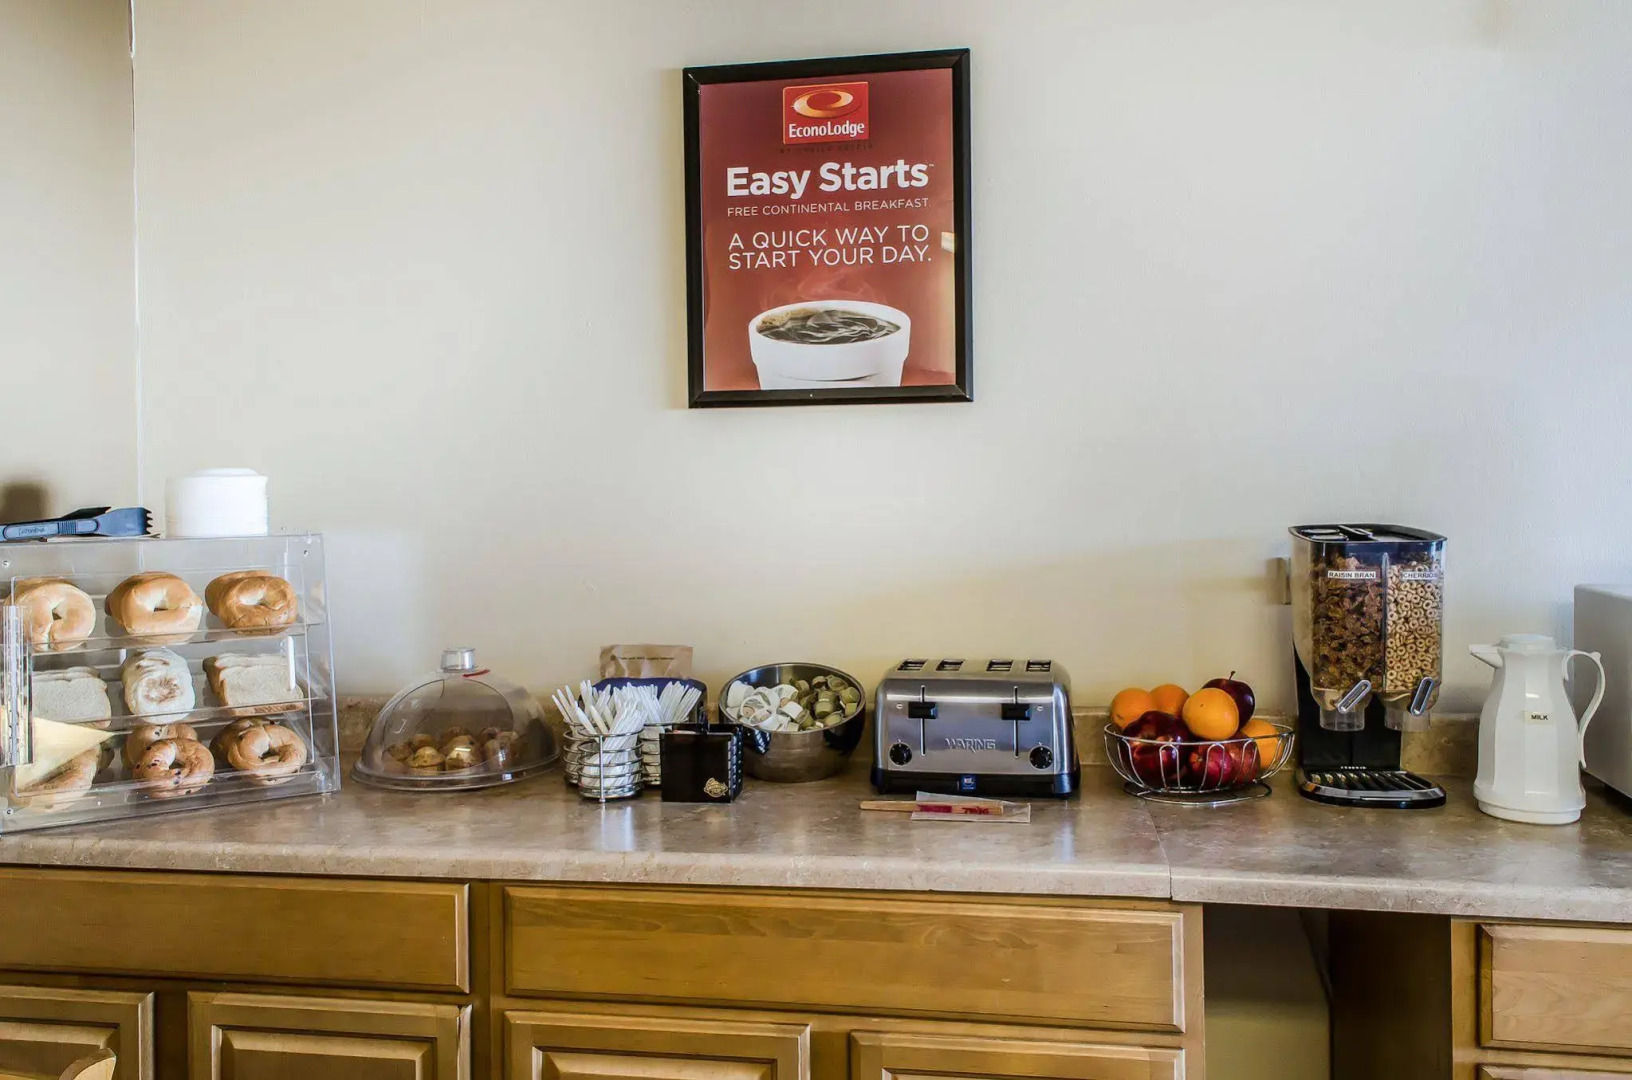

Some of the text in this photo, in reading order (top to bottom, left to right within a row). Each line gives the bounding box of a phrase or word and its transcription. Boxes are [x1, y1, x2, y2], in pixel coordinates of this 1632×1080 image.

[788, 120, 865, 138] EconoLodge
[727, 166, 811, 200] Easy
[727, 206, 759, 217] FREE
[762, 202, 850, 216] CONTINENTAL
[728, 224, 930, 251] A QUICK WAY TO
[728, 243, 932, 271] START YOUR DAY.
[1328, 571, 1353, 579] RAISIN
[944, 737, 996, 753] WARING
